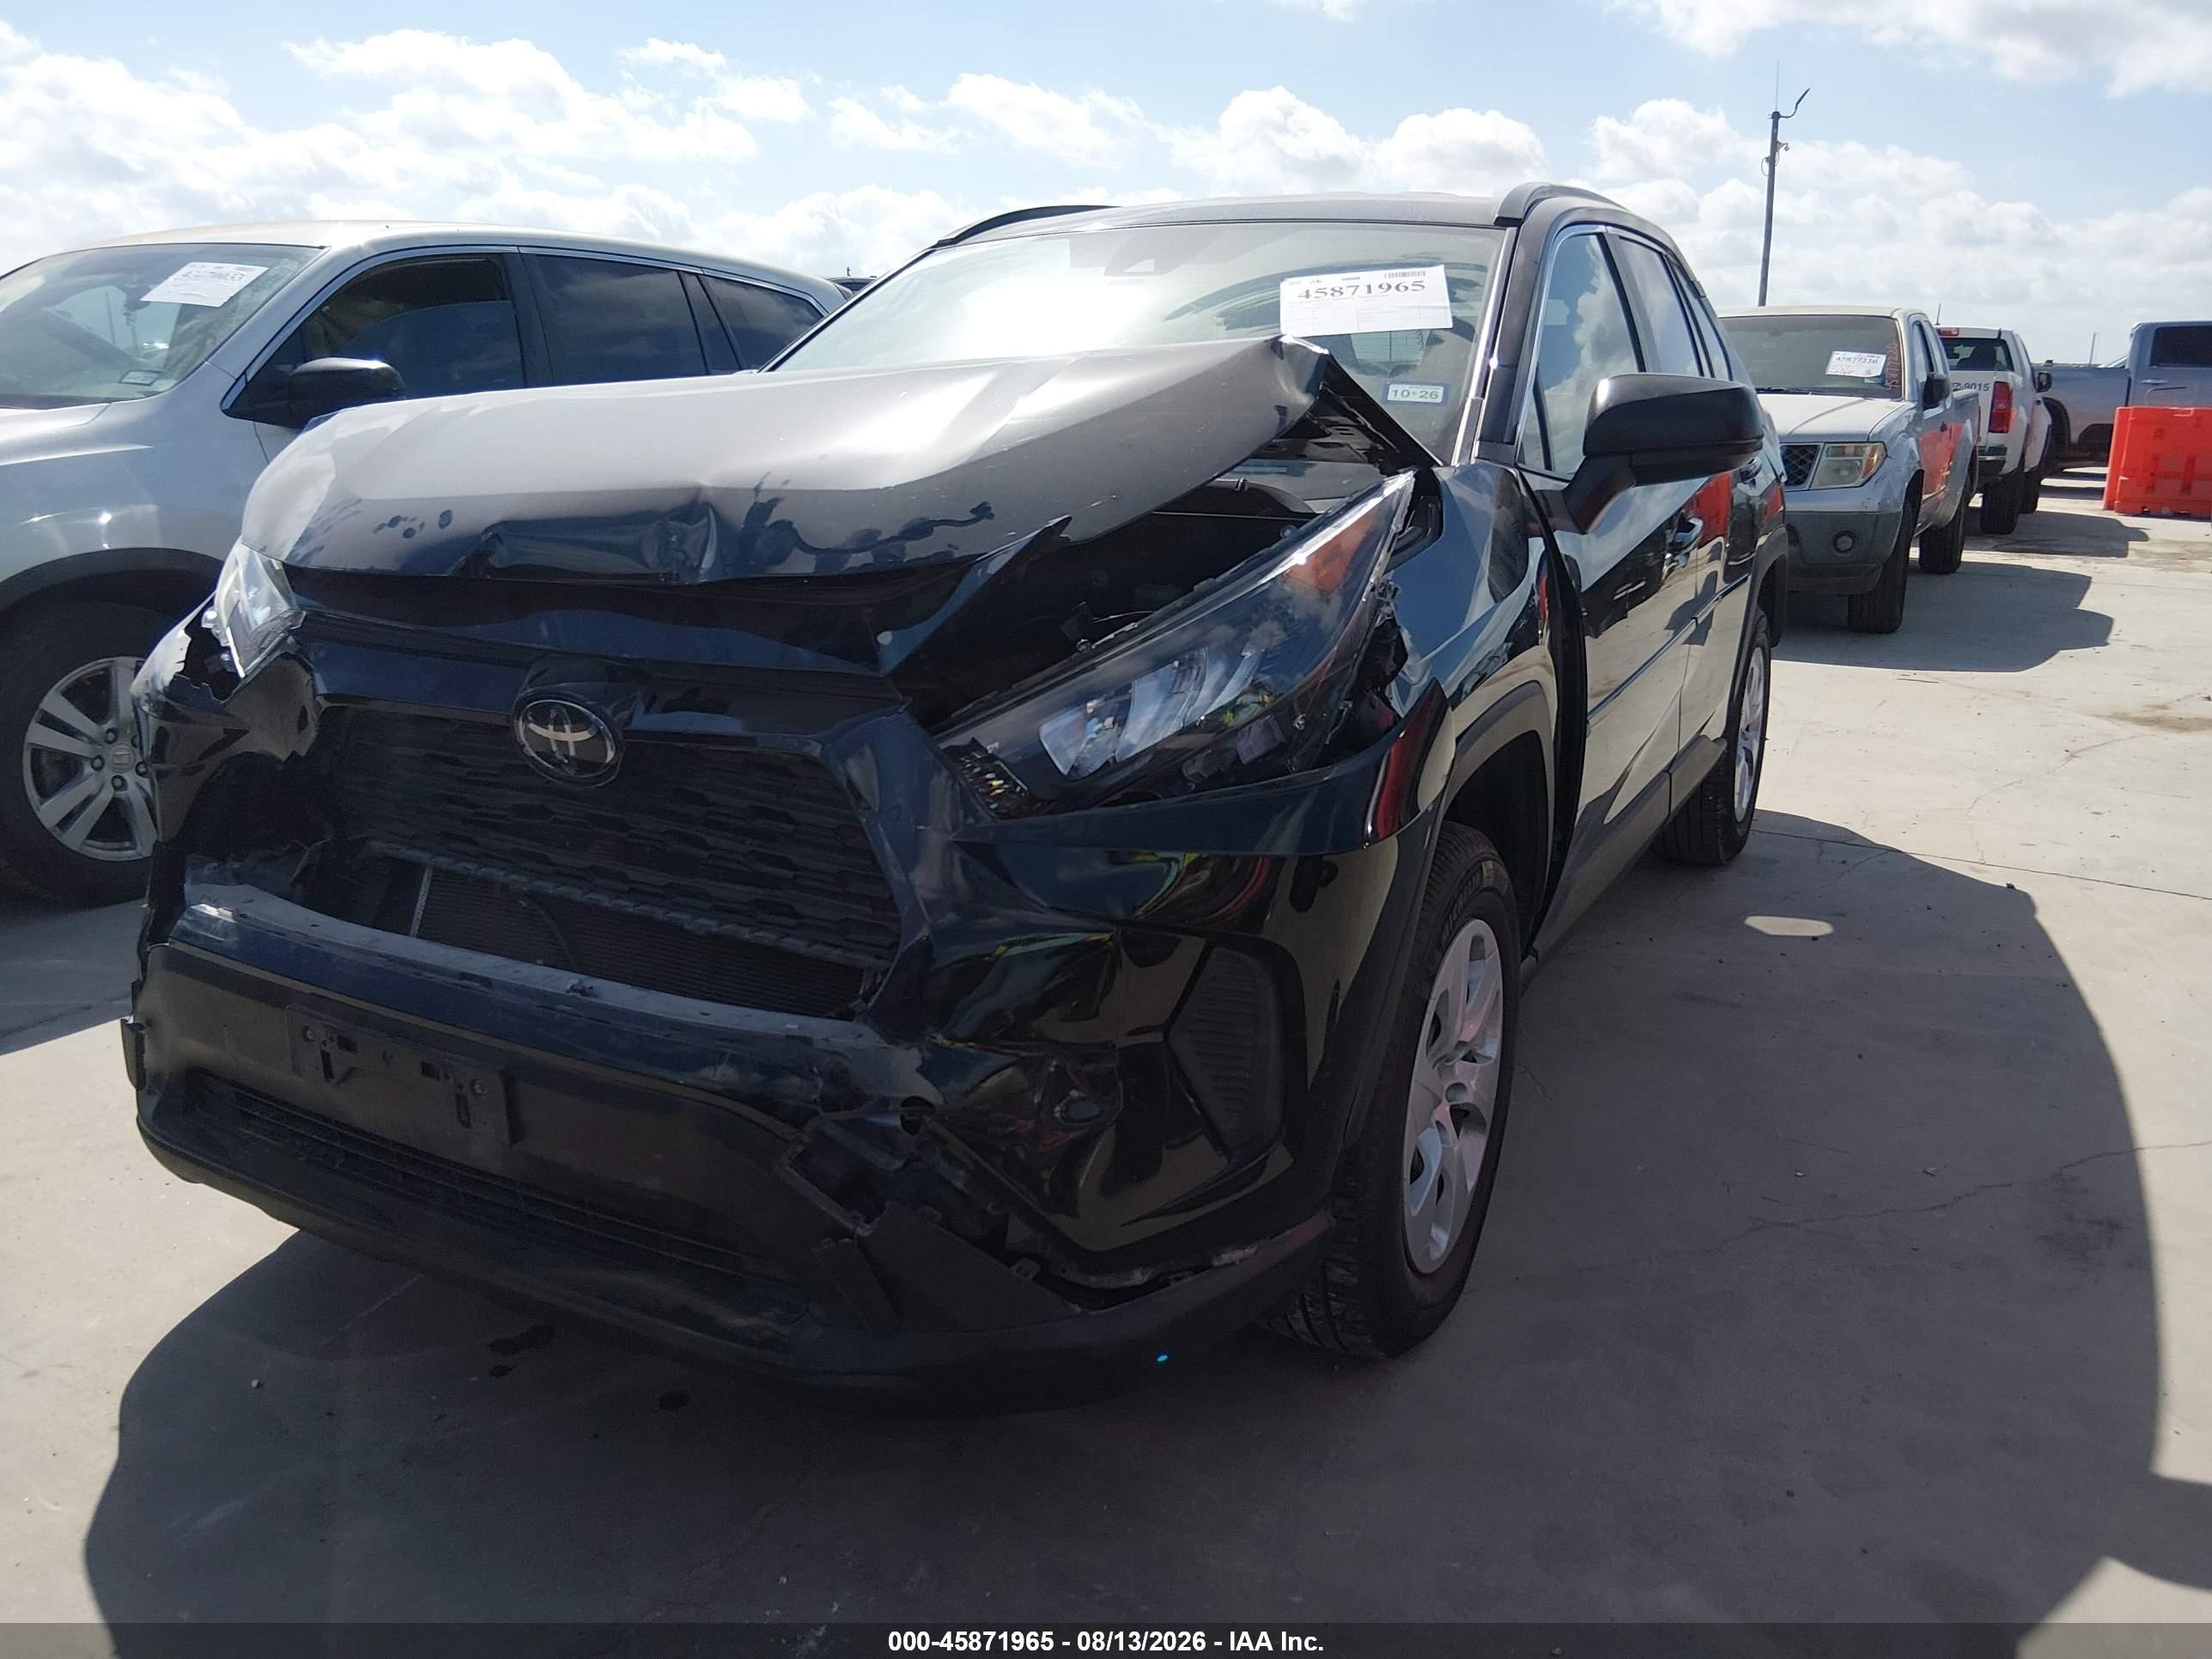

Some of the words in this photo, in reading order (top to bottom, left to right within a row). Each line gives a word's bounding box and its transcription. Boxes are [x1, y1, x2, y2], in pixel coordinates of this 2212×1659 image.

[1298, 281, 1425, 299] 45871965
[1392, 389, 1410, 398] 10
[1419, 390, 1439, 399] 26
